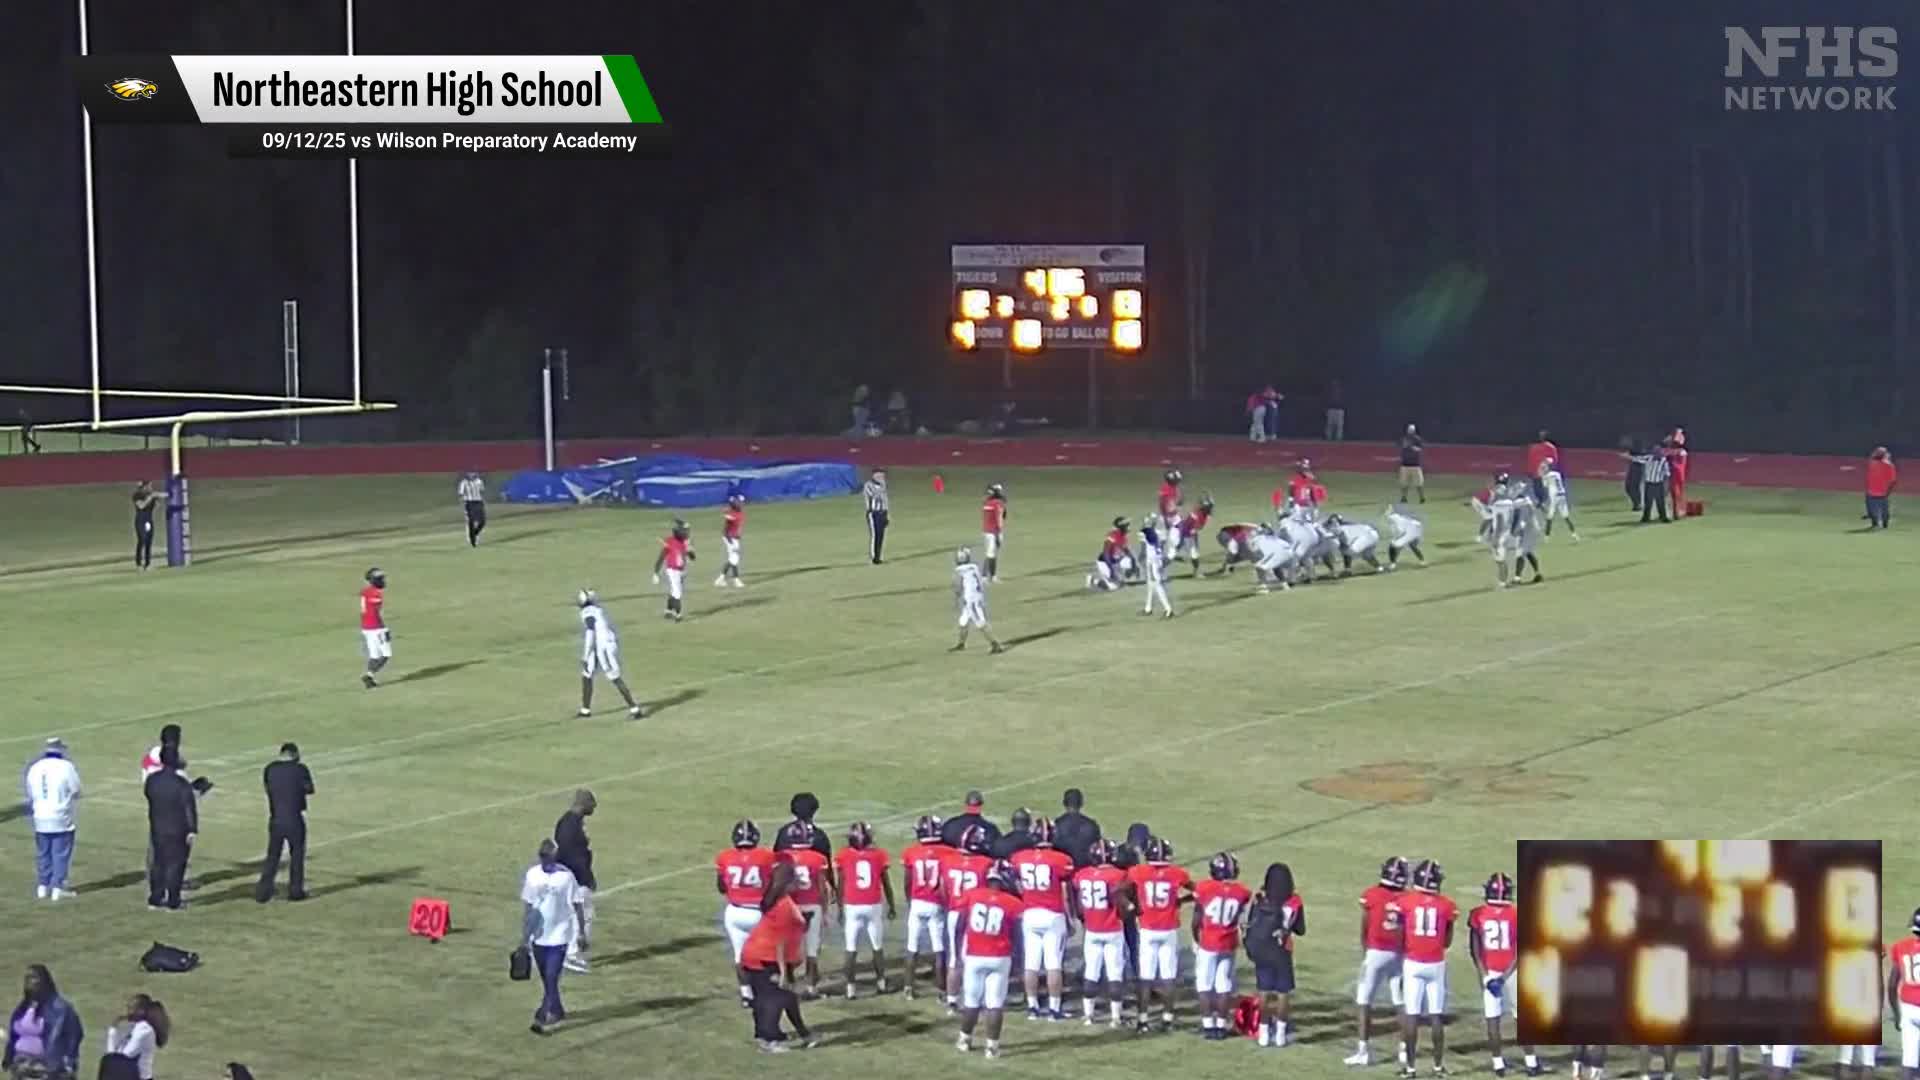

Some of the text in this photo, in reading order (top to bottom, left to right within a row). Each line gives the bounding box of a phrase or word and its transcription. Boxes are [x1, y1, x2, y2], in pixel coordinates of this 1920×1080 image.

[727, 865, 762, 889] 74
[855, 860, 872, 889] 9
[914, 859, 942, 887] 17
[1079, 880, 1108, 910] 32
[1144, 880, 1171, 908] 15
[414, 903, 443, 933] 20
[1204, 897, 1240, 927] 40
[1414, 906, 1437, 937] 11
[1483, 919, 1510, 950] 21
